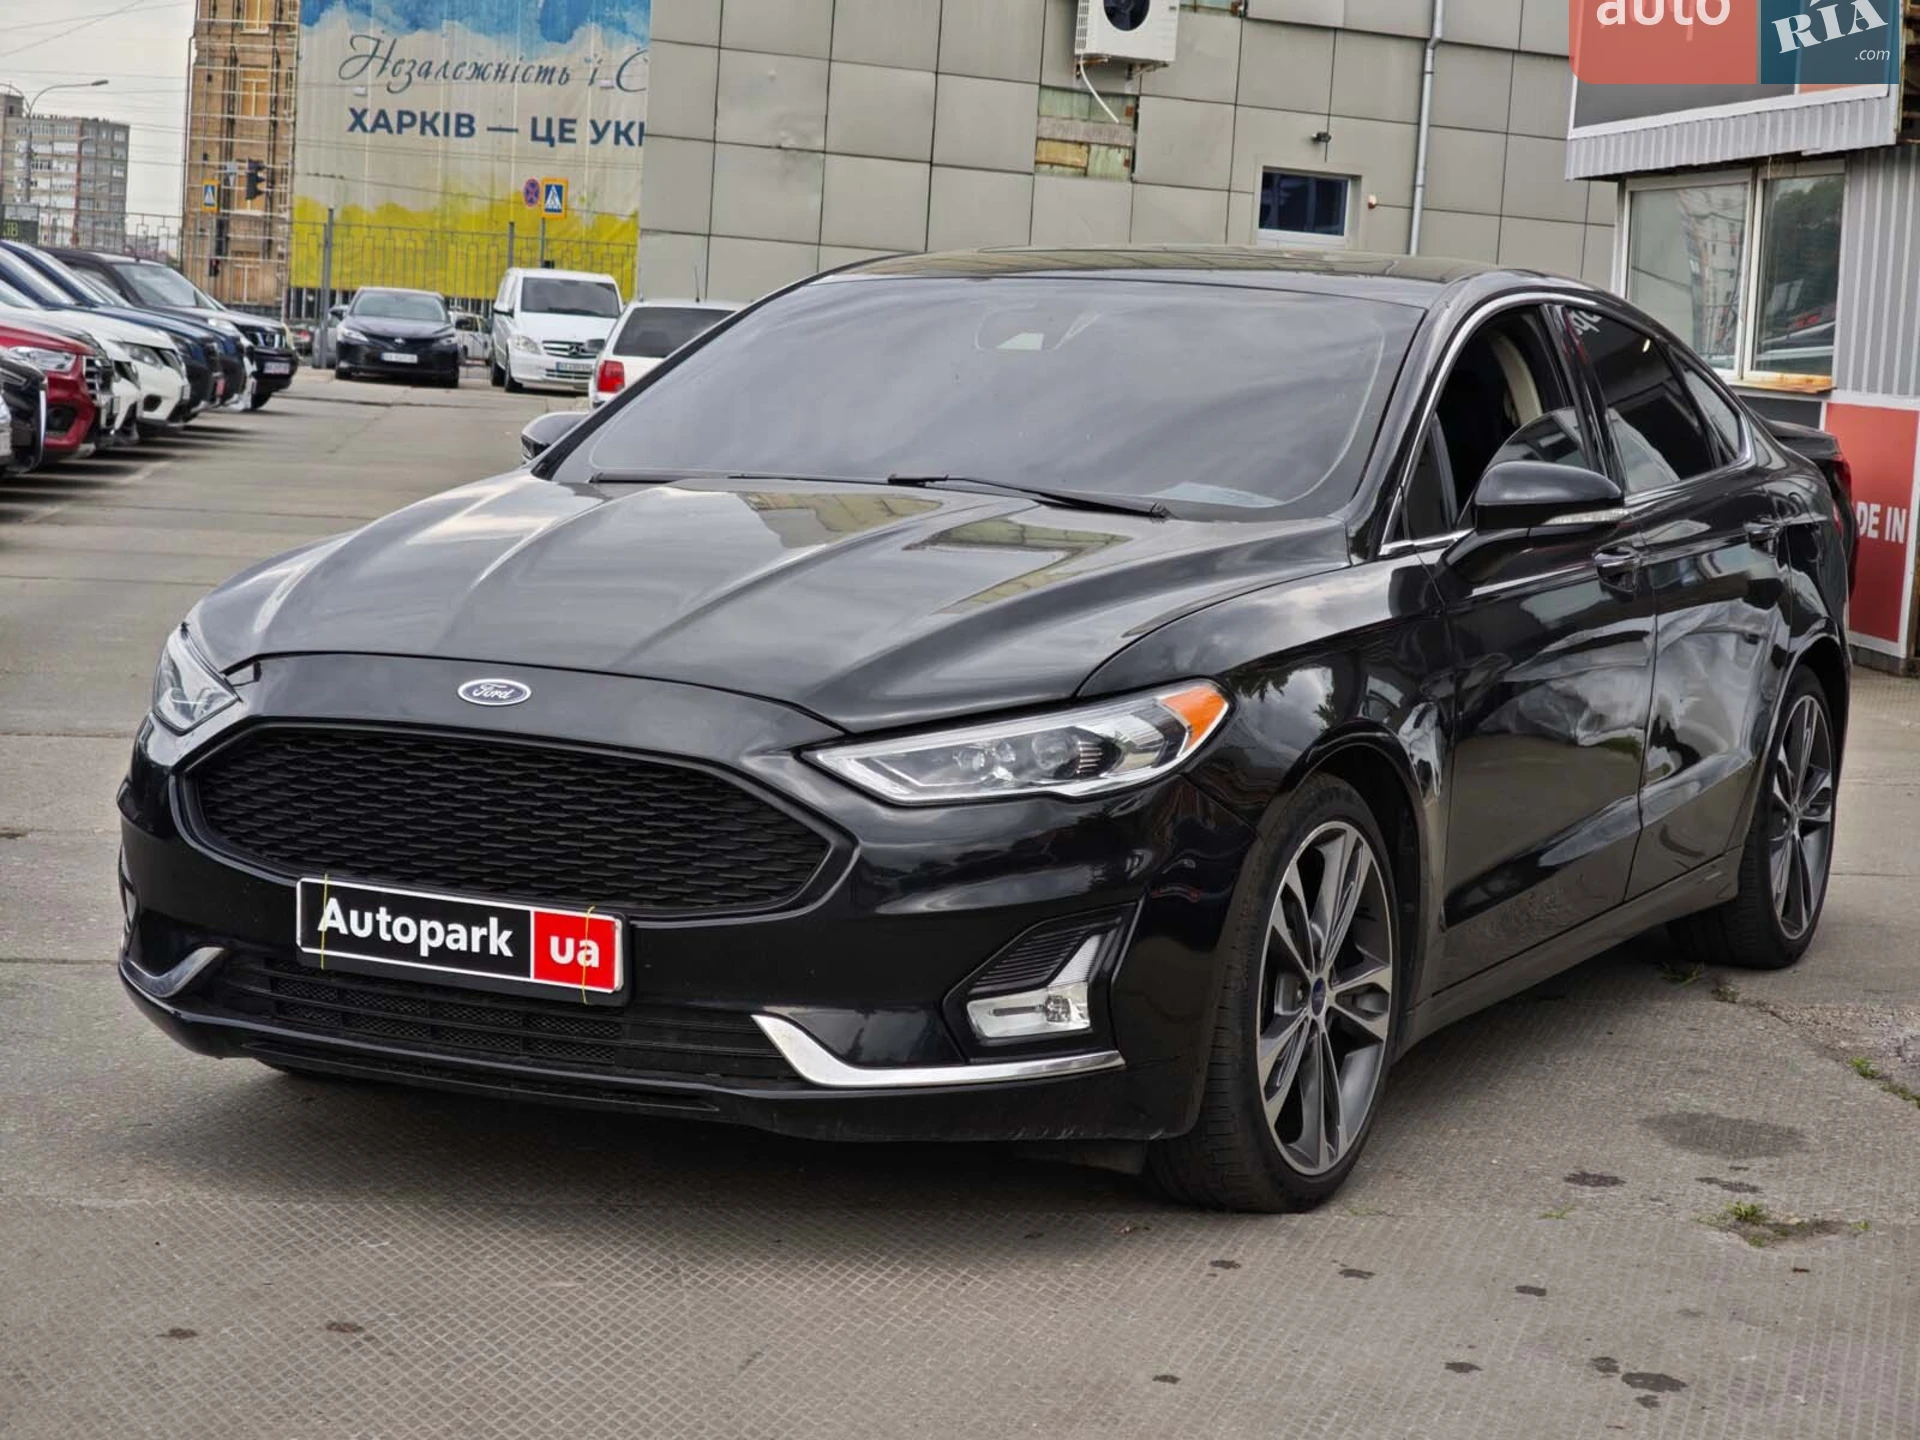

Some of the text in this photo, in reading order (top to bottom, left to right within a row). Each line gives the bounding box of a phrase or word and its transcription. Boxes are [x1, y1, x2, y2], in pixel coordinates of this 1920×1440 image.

[338, 34, 570, 94] Незалежність
[347, 106, 476, 138] ХАРКІВ
[530, 116, 577, 148] ЦЕ
[1884, 506, 1907, 544] IN
[472, 683, 515, 699] Ford
[317, 897, 600, 968] Autopark ua
